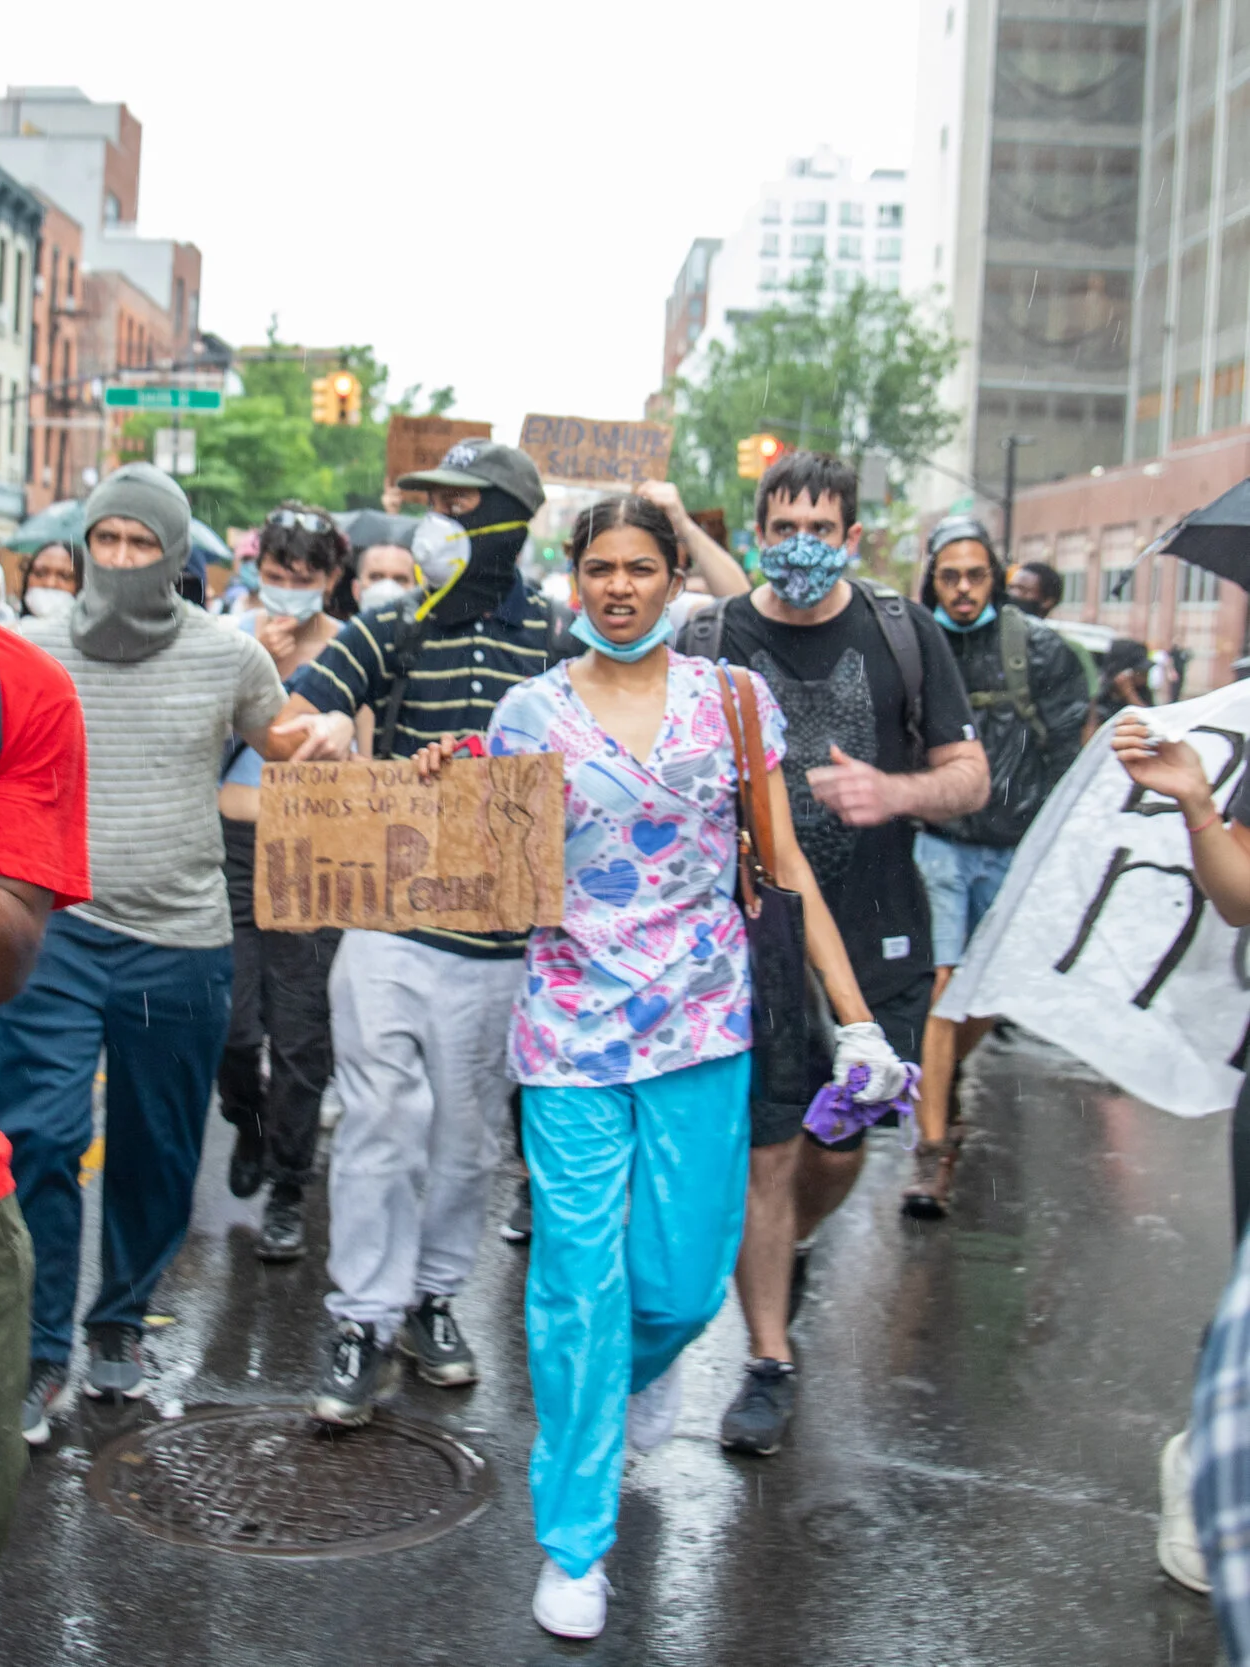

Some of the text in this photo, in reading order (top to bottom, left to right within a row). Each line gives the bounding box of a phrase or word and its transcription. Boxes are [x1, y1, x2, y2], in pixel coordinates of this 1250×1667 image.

[524, 415, 667, 458] END WHITE
[547, 451, 649, 482] SILENCE
[284, 796, 352, 818] HANDS
[367, 795, 397, 814] UP
